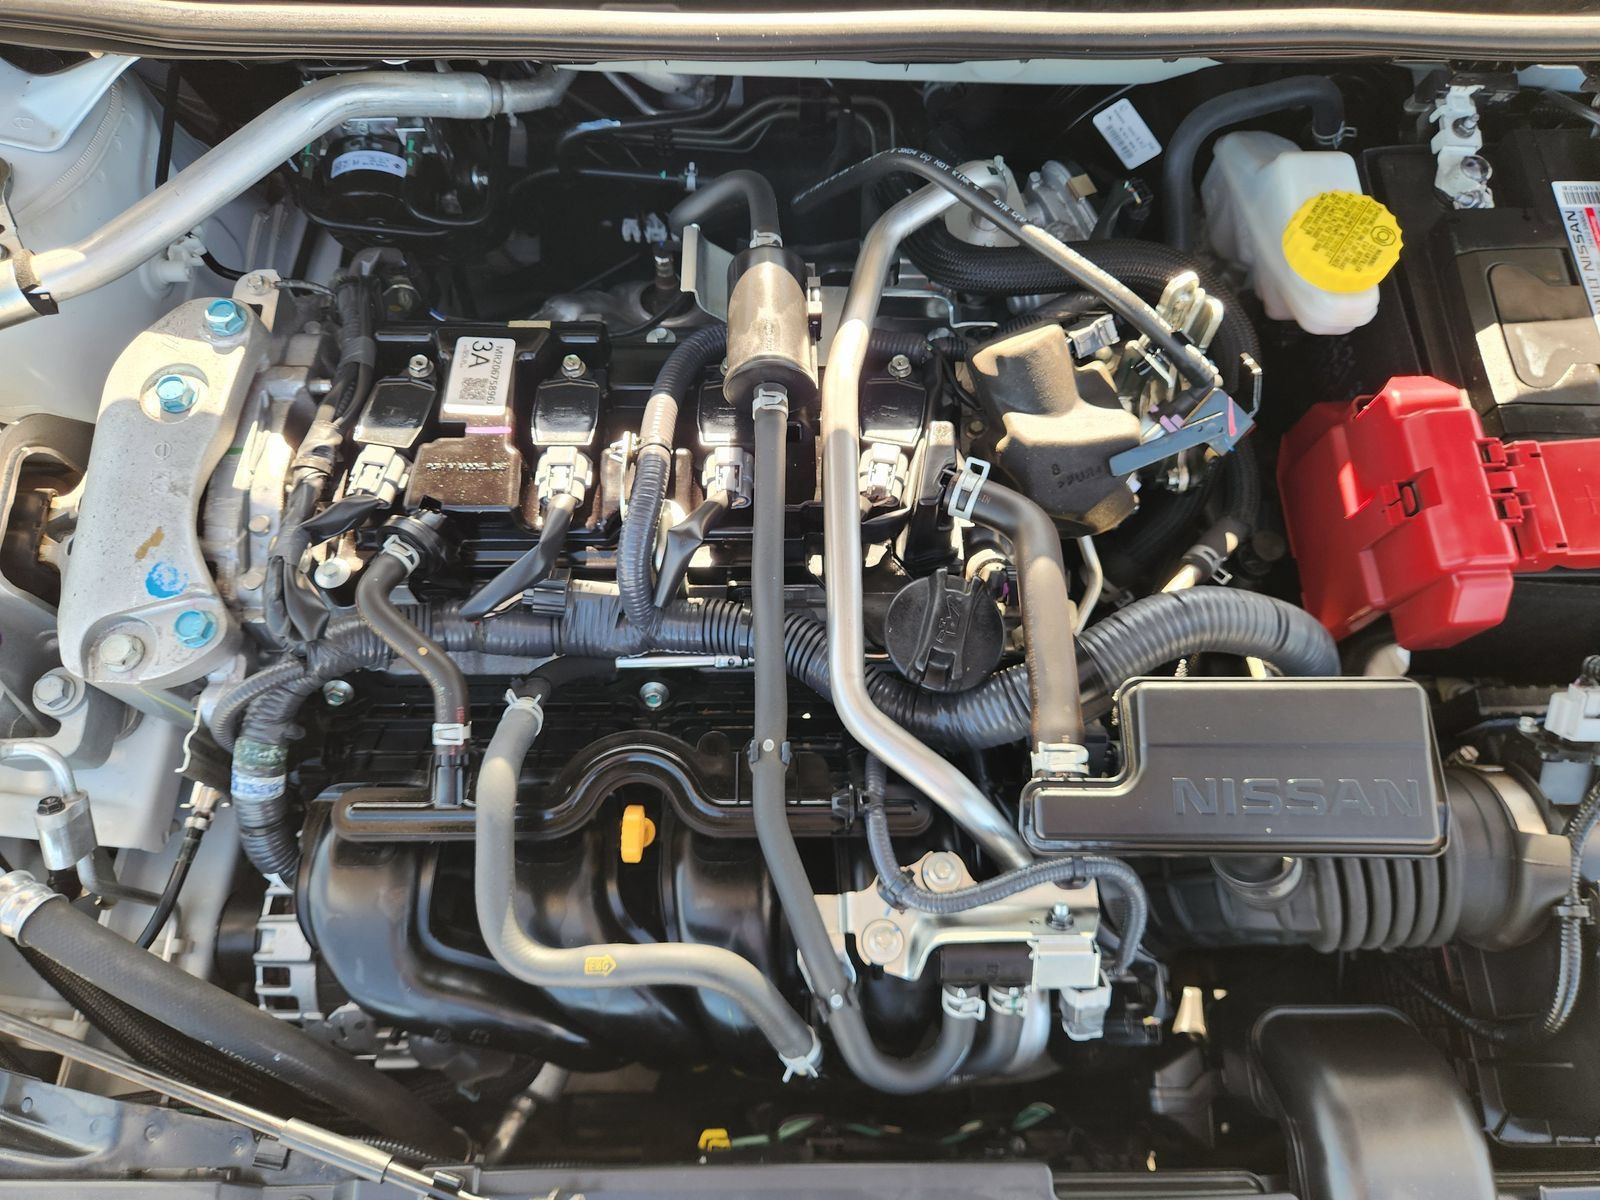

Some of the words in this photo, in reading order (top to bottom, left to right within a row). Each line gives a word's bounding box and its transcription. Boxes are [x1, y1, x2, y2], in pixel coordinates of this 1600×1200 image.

[1564, 210, 1595, 271] NISSAN
[468, 340, 493, 368] 3A
[1171, 777, 1422, 817] NISSAN
